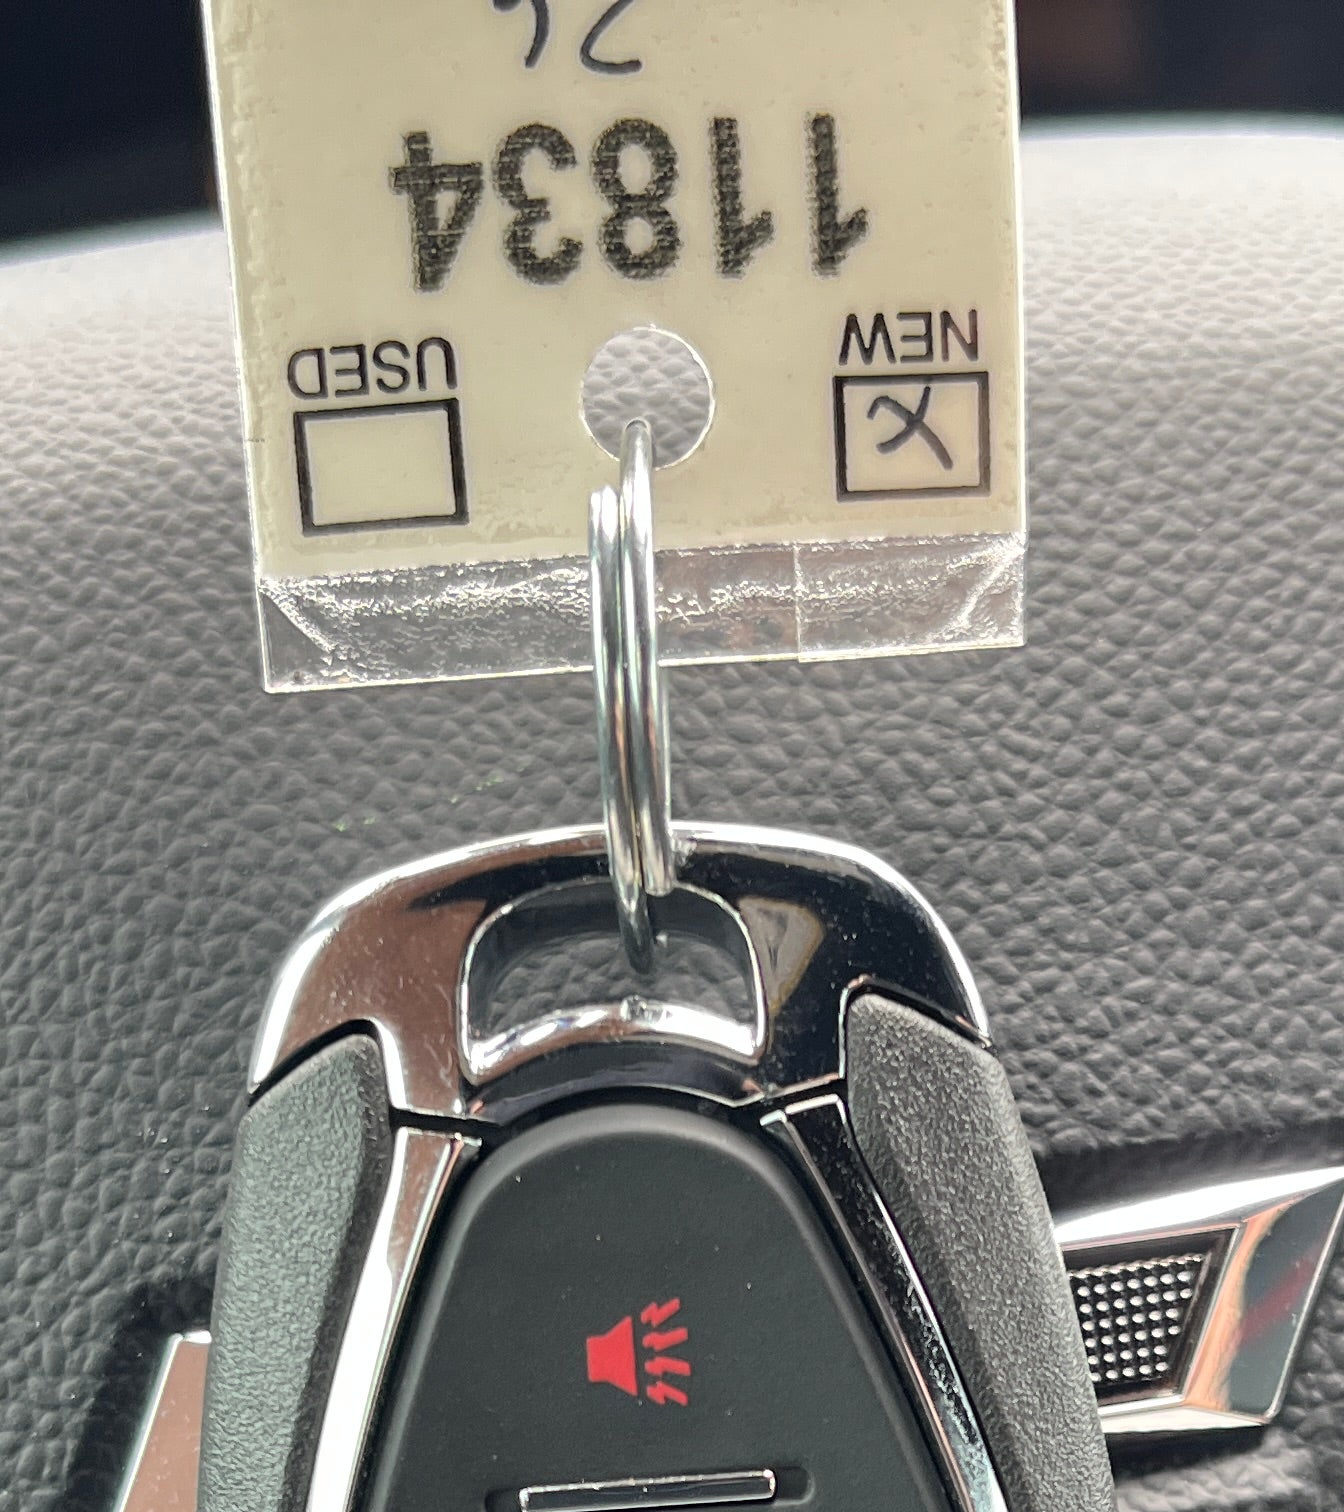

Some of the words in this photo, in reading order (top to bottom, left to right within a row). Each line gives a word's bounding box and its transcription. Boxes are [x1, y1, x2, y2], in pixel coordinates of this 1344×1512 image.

[390, 112, 869, 292] 11834
[286, 335, 458, 400] USED
[838, 308, 979, 366] NEW
